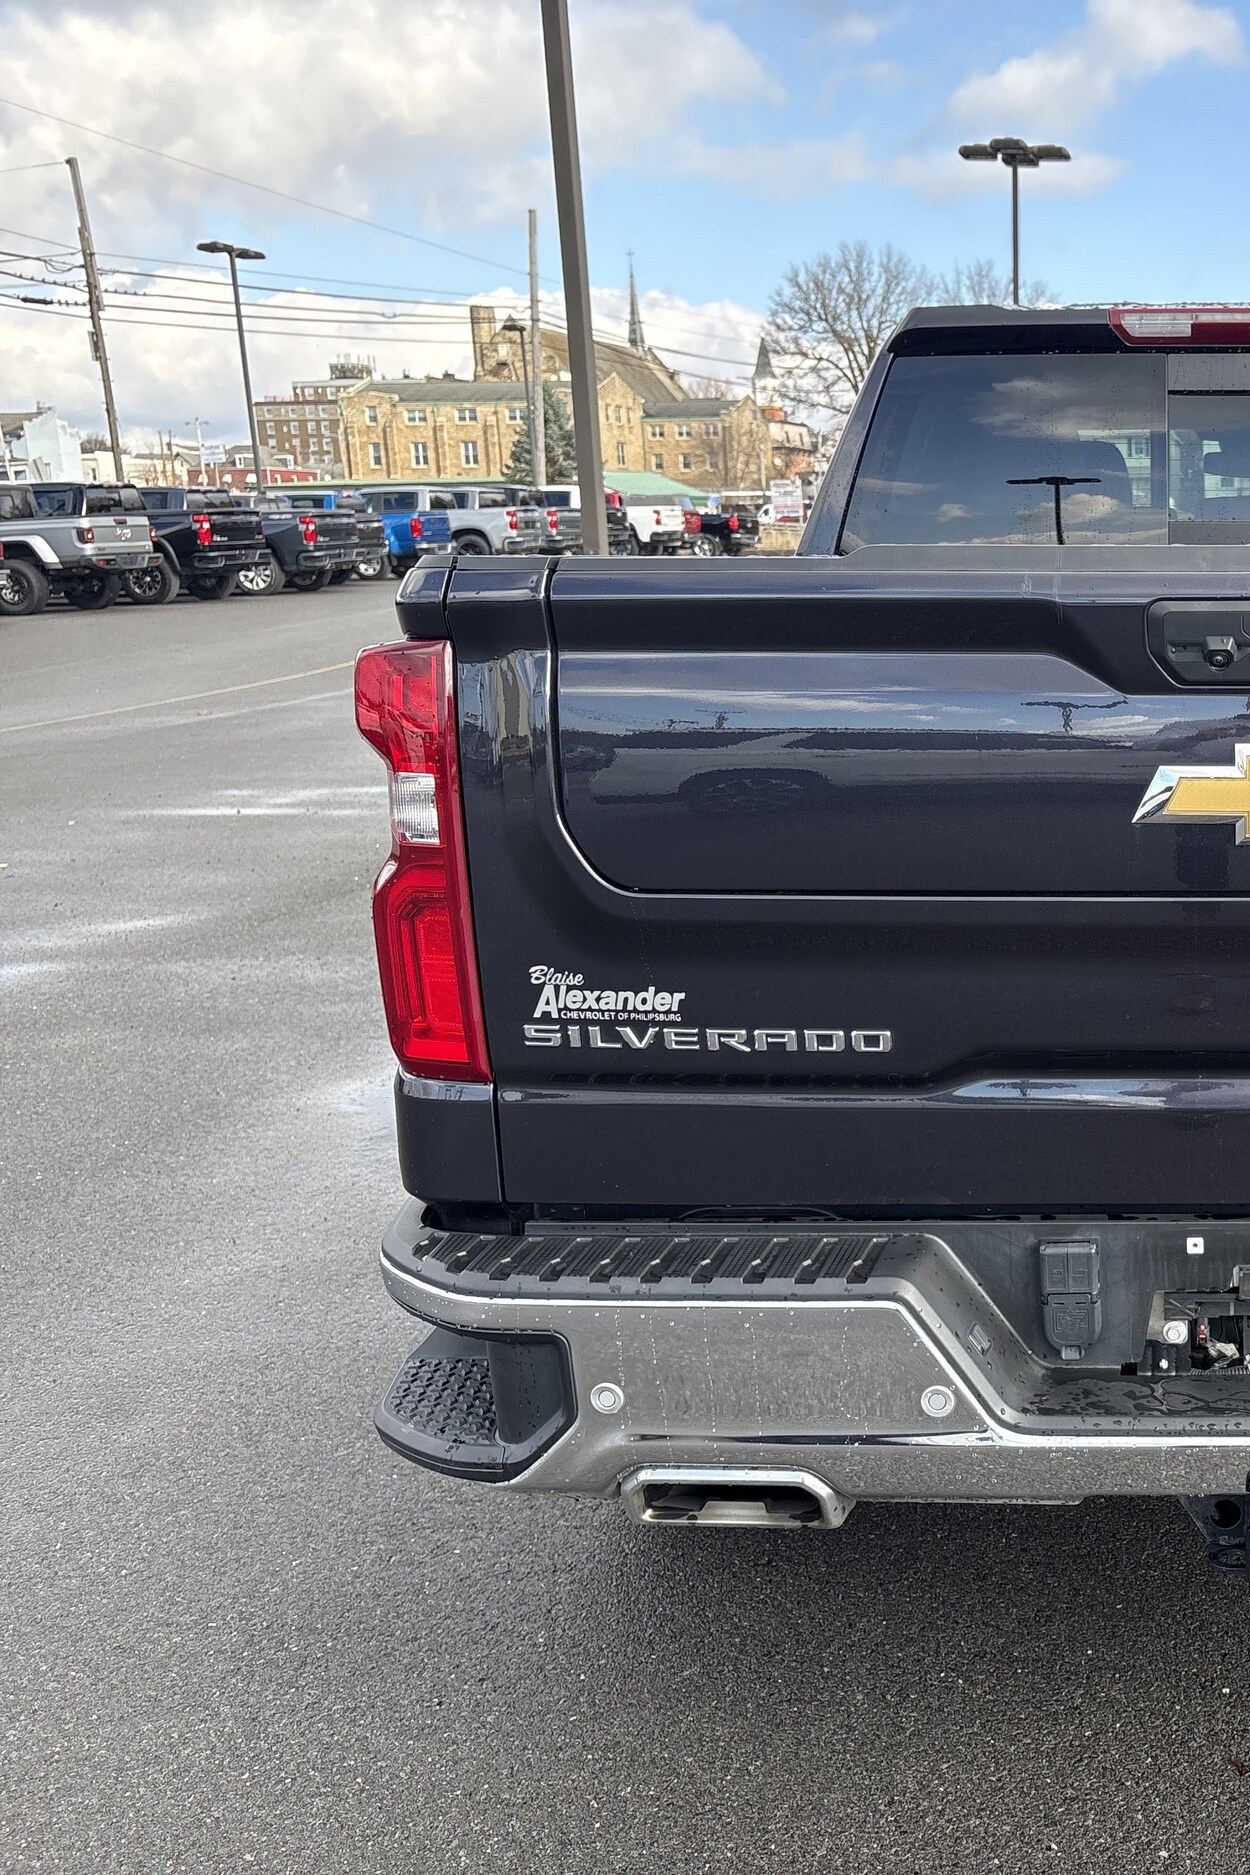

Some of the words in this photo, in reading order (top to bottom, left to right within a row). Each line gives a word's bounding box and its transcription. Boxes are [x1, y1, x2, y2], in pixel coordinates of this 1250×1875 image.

[528, 965, 585, 985] Blaise
[533, 985, 685, 1018] Alexander
[560, 1010, 616, 1020] CHEVROLET
[617, 1012, 629, 1020] OF
[630, 1013, 682, 1022] PHILIPSBURG
[522, 1024, 893, 1053] SILVERADO
